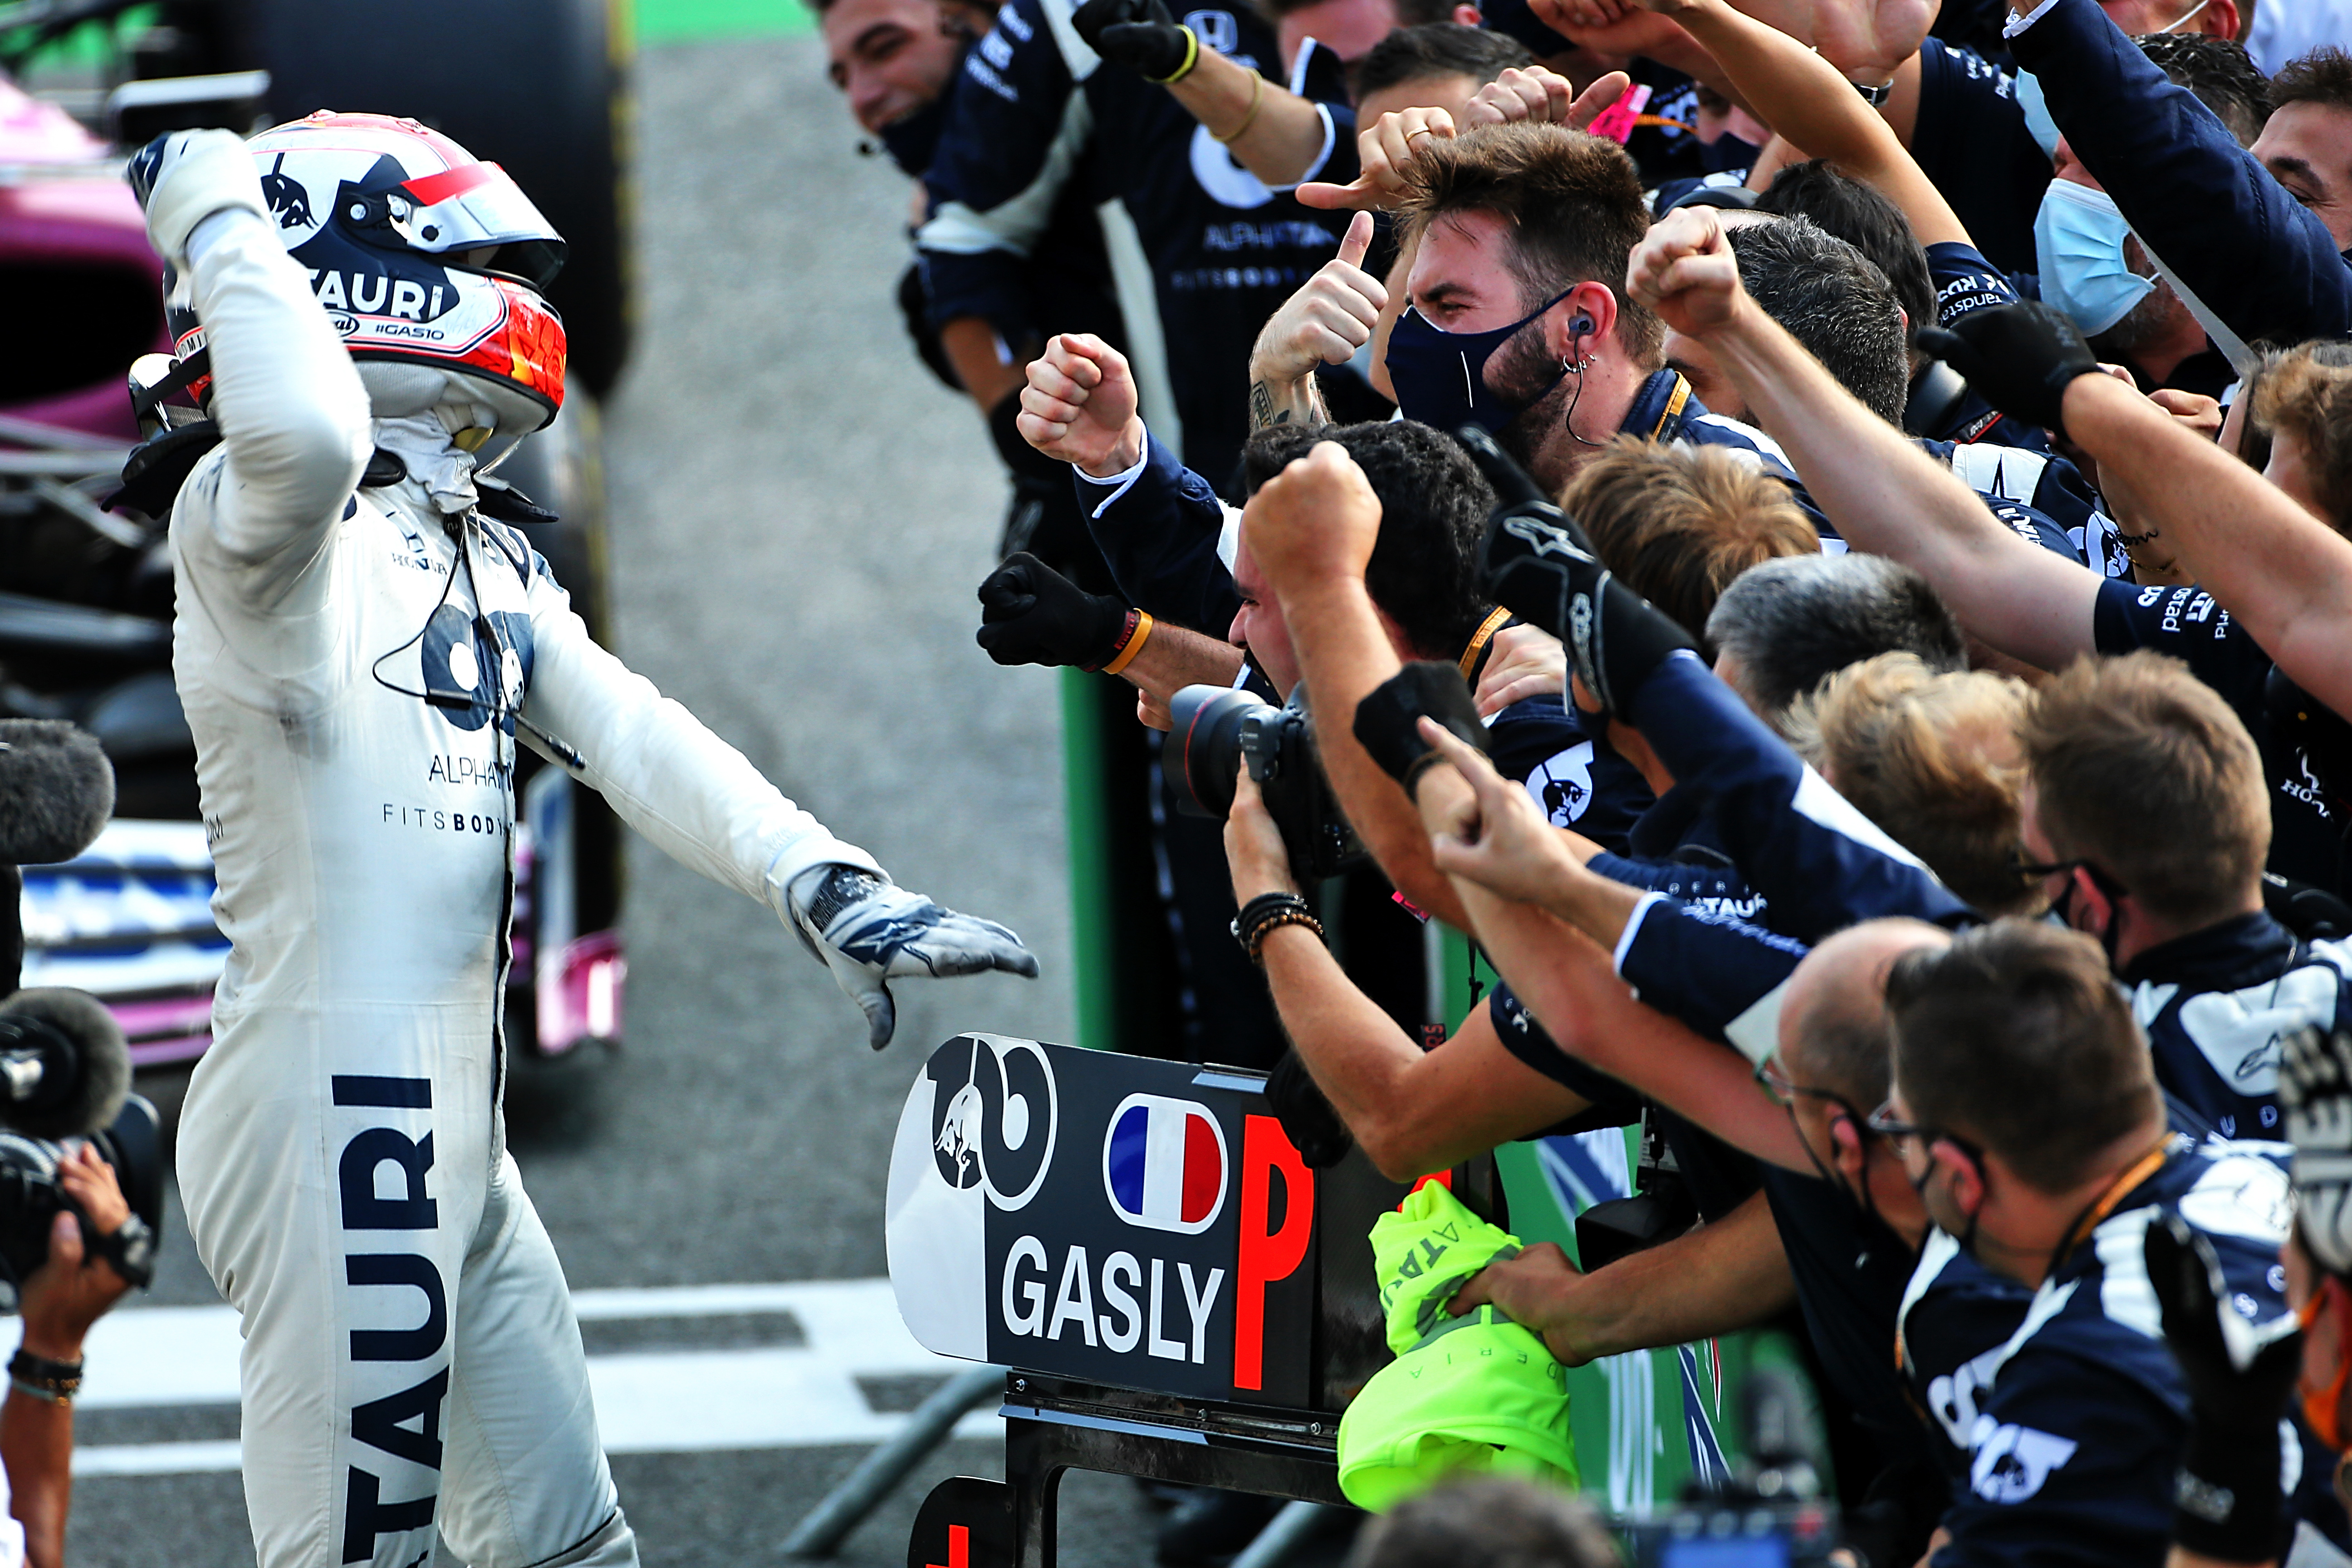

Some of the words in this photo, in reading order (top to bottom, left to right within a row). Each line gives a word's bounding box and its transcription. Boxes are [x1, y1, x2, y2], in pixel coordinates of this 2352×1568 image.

[309, 269, 443, 321] AURI
[332, 1075, 450, 1568] TAURI
[1002, 1235, 1225, 1364] GASLY
[1234, 1114, 1314, 1390] P
